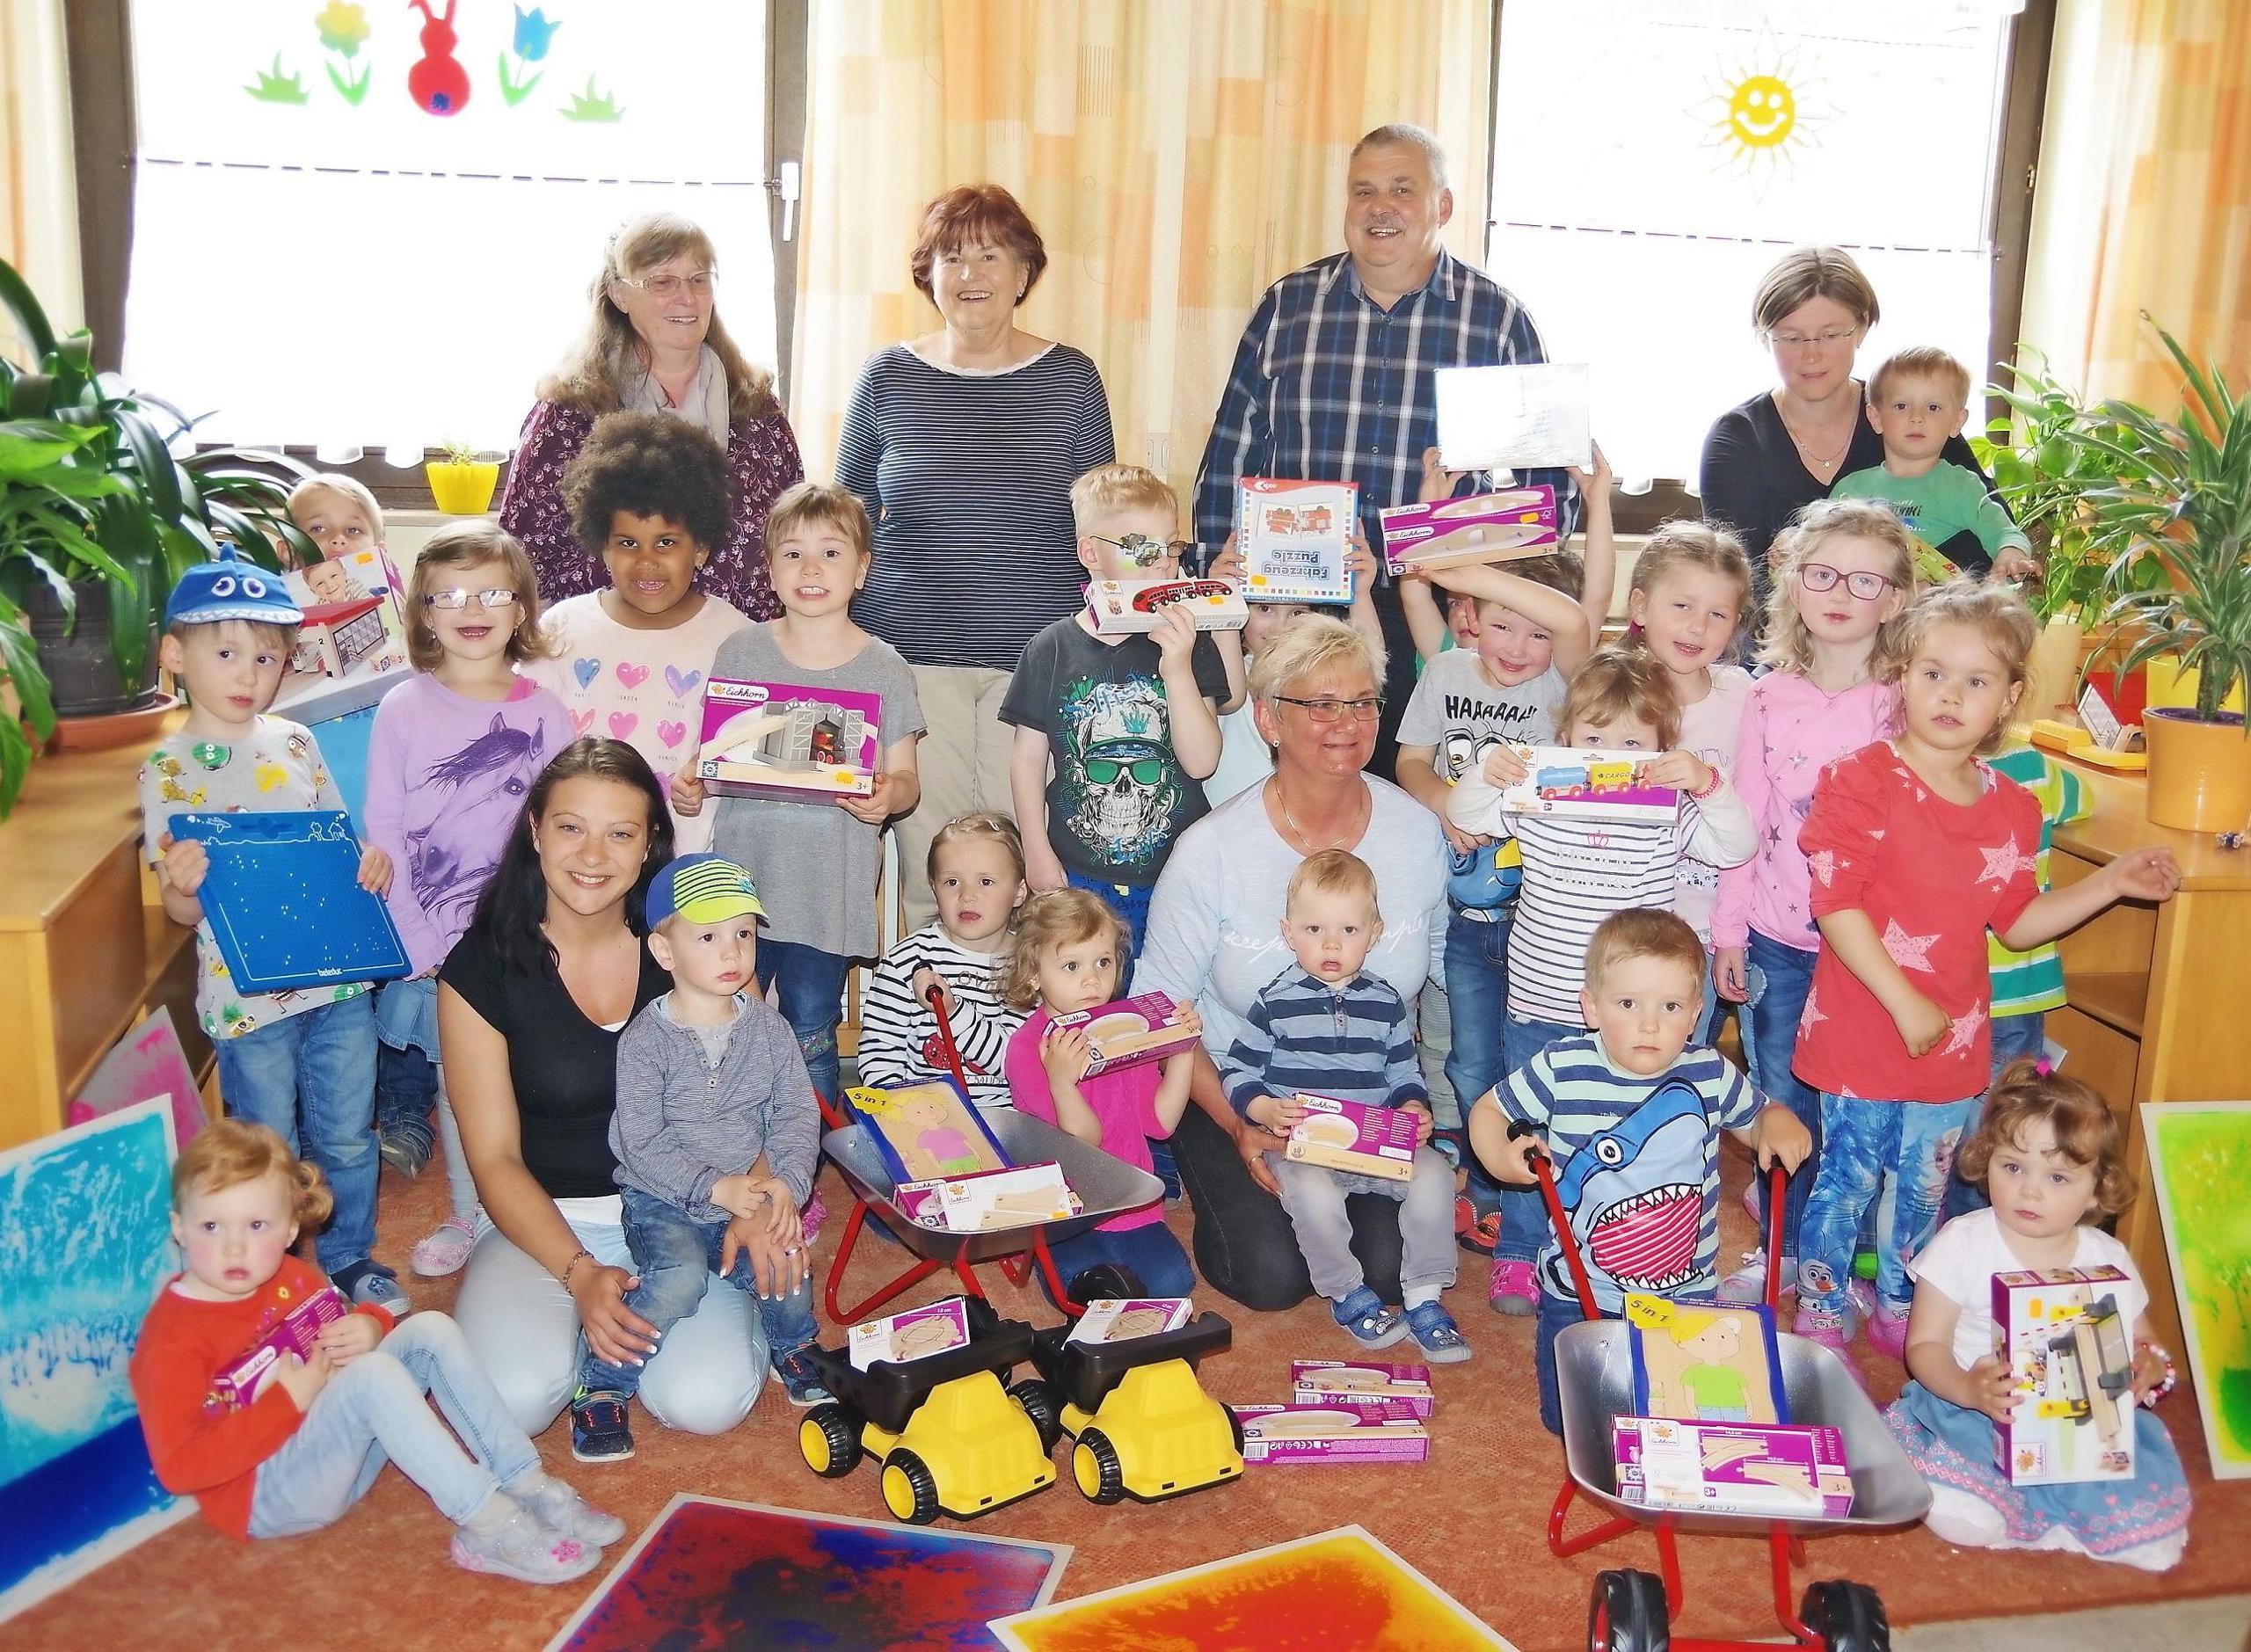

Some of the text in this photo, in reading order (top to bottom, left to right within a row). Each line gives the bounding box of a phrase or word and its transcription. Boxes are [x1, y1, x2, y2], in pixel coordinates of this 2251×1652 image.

[1396, 505, 1428, 514] Eichhorn
[1400, 528, 1432, 538] Eichhorn
[1272, 550, 1319, 564] Puzzle
[1264, 563, 1329, 579] Fahrzeug
[725, 686, 766, 699] Eichhorn
[317, 967, 343, 976] beleduc
[864, 1095, 877, 1104] in
[1308, 1099, 1340, 1112] Eichhorn
[1397, 1167, 1408, 1175] 3+
[1630, 1299, 1640, 1309] 5
[1643, 1305, 1656, 1317] in
